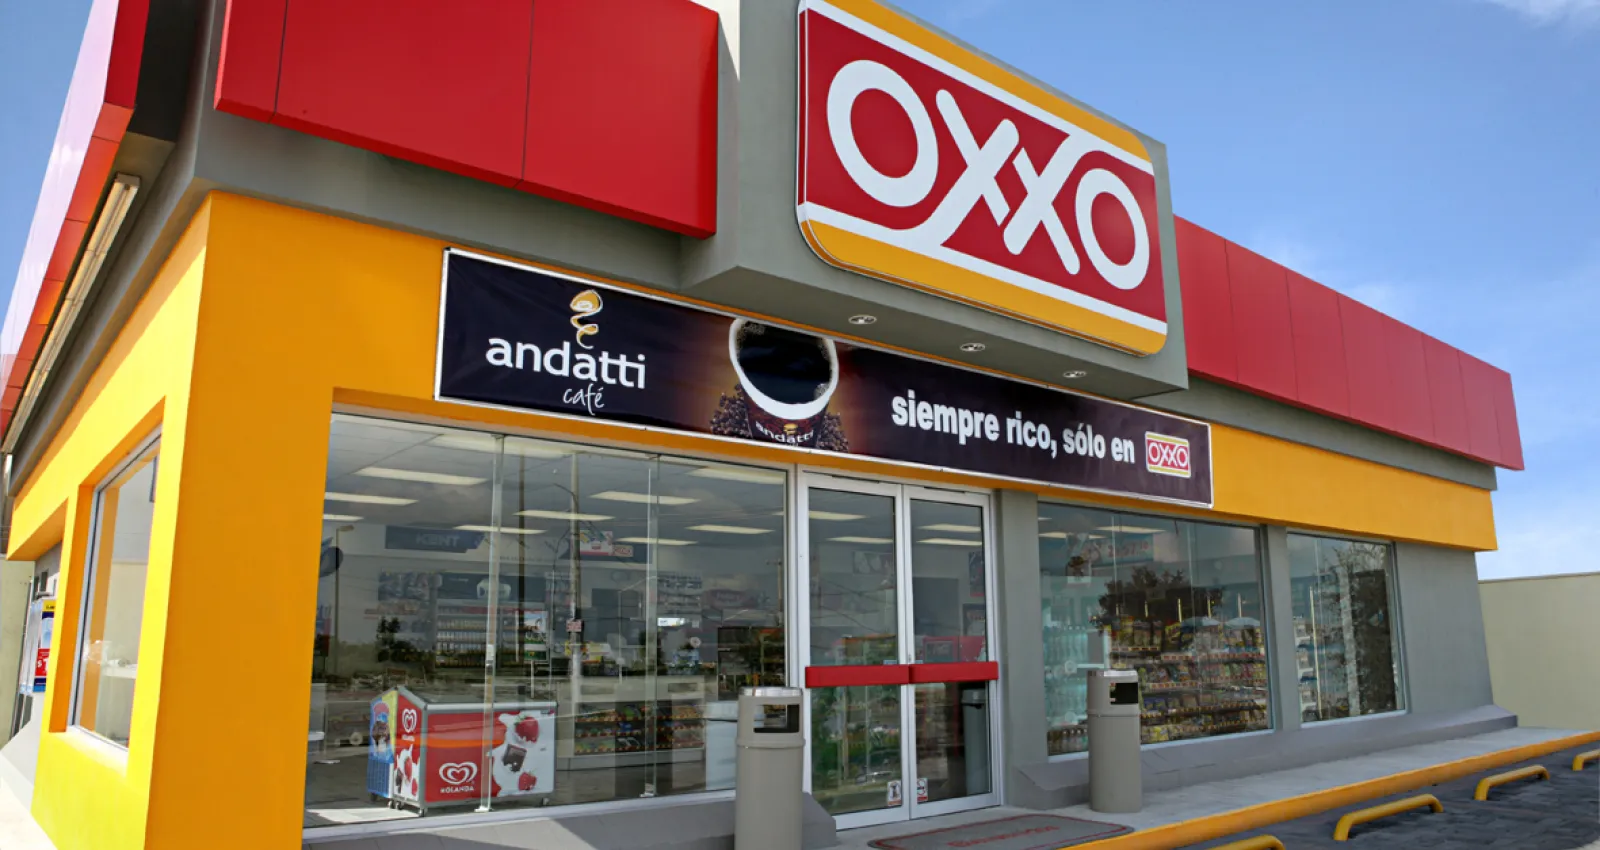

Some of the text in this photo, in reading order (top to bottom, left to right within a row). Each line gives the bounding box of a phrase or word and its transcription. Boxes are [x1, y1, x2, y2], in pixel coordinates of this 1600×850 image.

[826, 59, 1150, 291] OXXO
[485, 337, 646, 389] andatti
[562, 383, 605, 416] café
[891, 389, 1188, 468] siempre rico, sólo en OXXO
[415, 533, 460, 548] KENT
